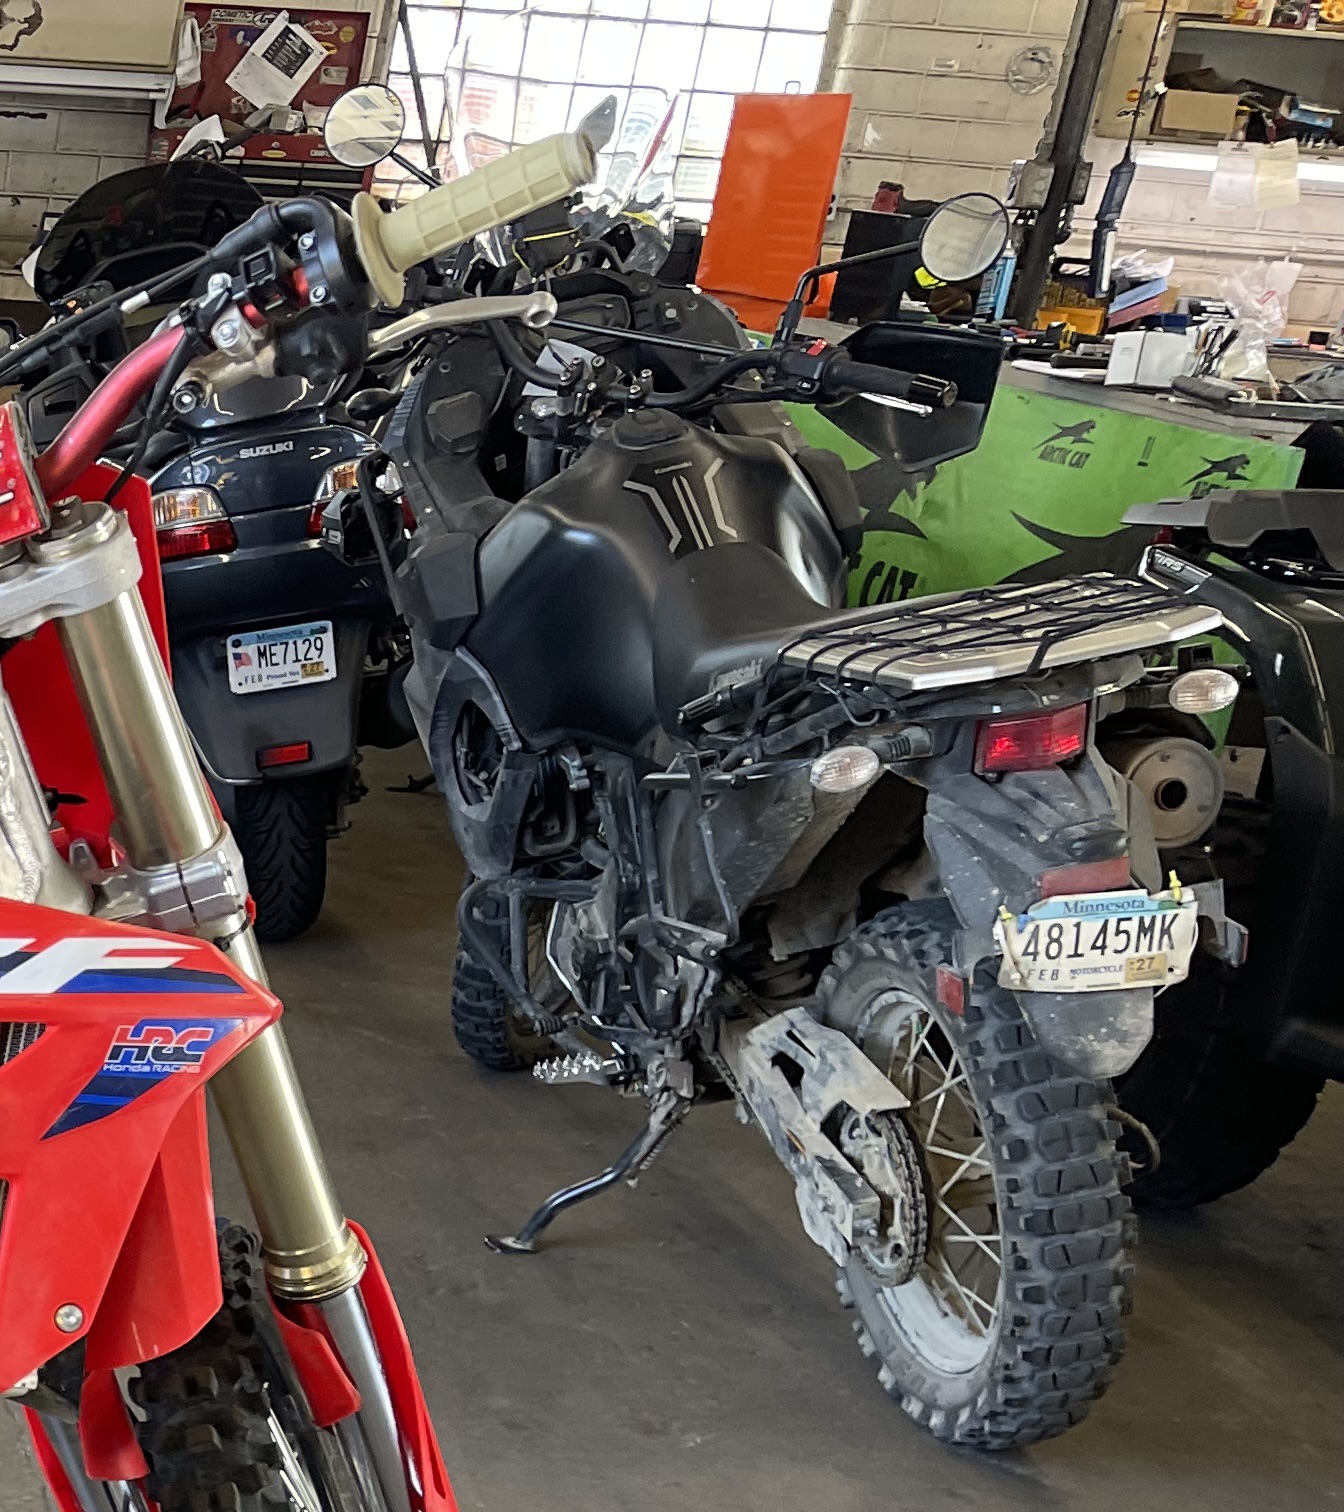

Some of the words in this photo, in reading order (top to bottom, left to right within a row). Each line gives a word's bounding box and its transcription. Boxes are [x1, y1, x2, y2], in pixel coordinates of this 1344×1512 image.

[239, 441, 294, 459] SUZUKI
[257, 637, 323, 668] ME7129
[1063, 900, 1145, 915] Minnesota
[1022, 913, 1179, 962] 48145MK
[1136, 957, 1155, 971] 27
[1027, 969, 1060, 981] FEB
[1070, 965, 1123, 977] MOTORCYCLE
[104, 1025, 214, 1065] HRC
[103, 1064, 150, 1072] Honda
[152, 1065, 200, 1073] RACING
